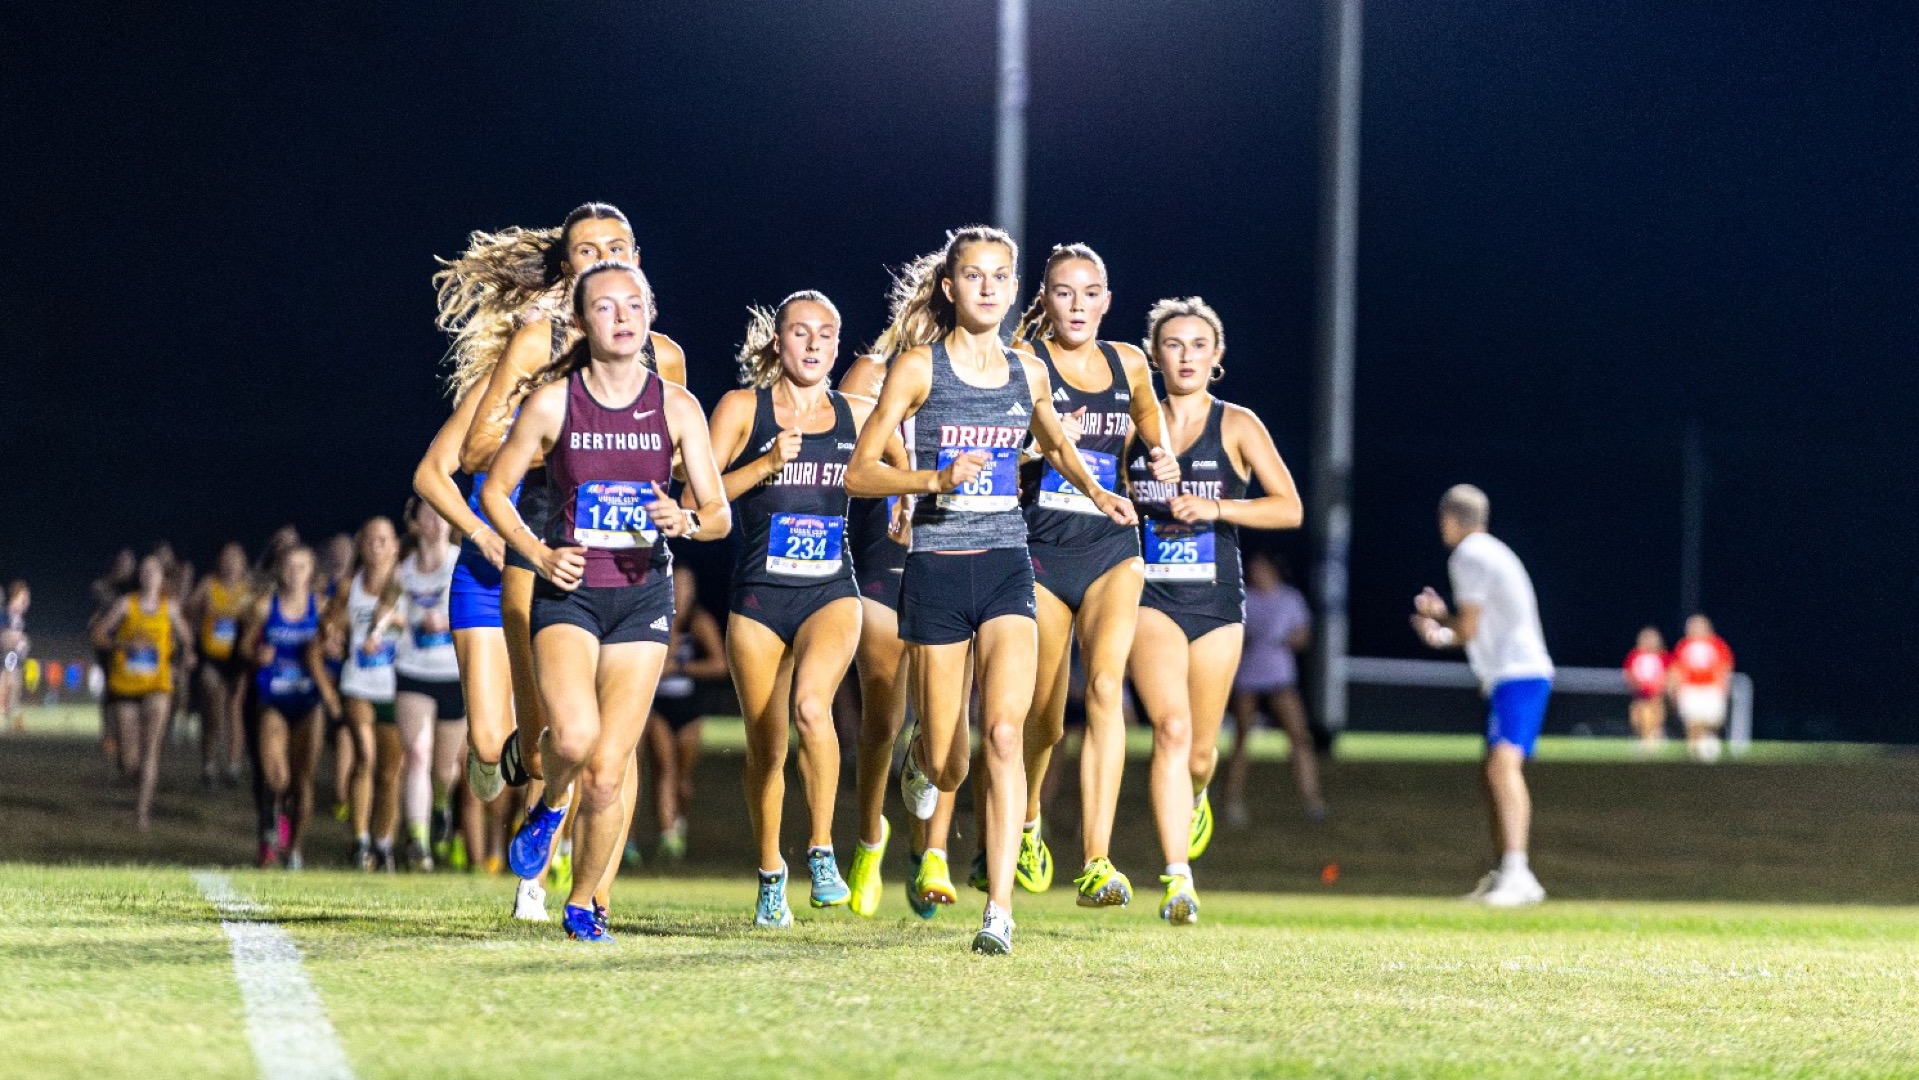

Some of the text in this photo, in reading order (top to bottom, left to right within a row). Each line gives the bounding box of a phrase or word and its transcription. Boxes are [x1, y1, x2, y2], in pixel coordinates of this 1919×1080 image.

[570, 432, 662, 450] BERTHOUD
[940, 425, 1026, 448] DRURY
[1133, 480, 1222, 502] SSOURI STATE
[589, 505, 647, 530] 1479
[785, 537, 827, 559] 234
[1158, 541, 1199, 563] 225
